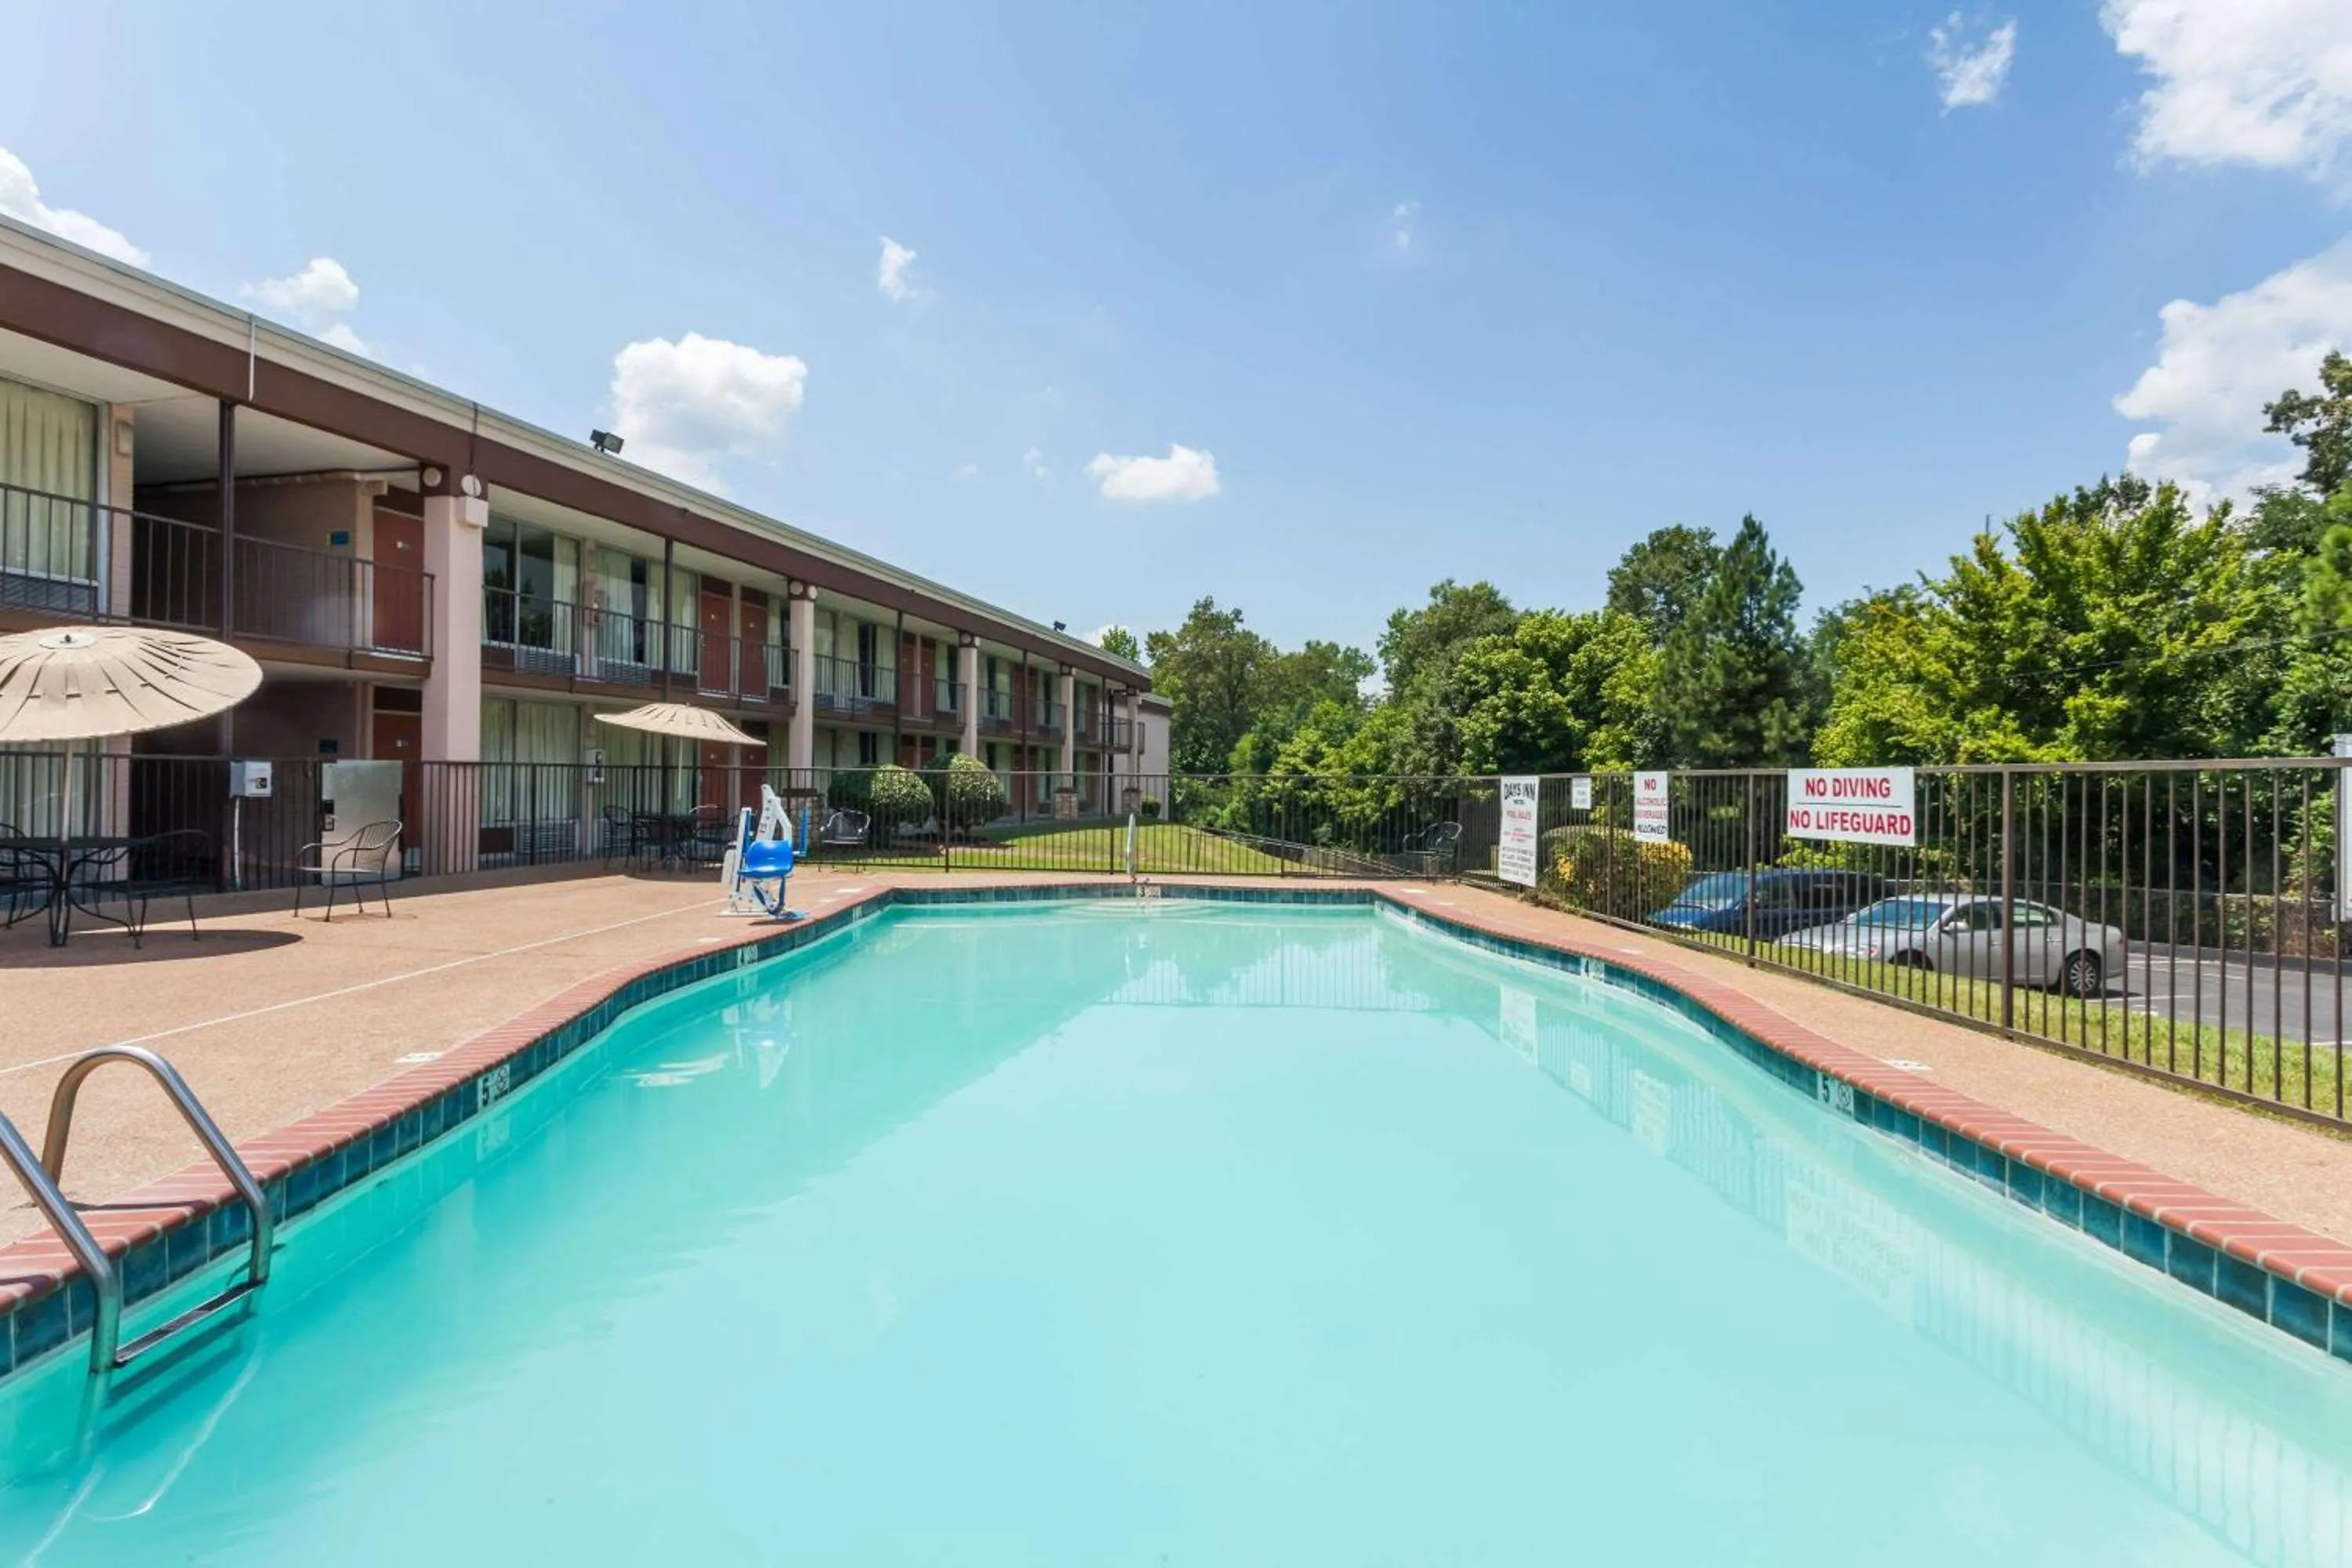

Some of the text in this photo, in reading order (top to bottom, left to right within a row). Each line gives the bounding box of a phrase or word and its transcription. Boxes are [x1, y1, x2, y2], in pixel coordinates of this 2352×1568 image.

[1504, 782, 1536, 801] DAYS INN
[1643, 778, 1657, 791] NO
[1805, 777, 1891, 799] NO DIVING
[1789, 809, 1911, 836] NO LIFEGUARD
[1139, 886, 1145, 898] 3
[481, 1076, 490, 1107] 5
[1820, 1073, 1831, 1104] 5
